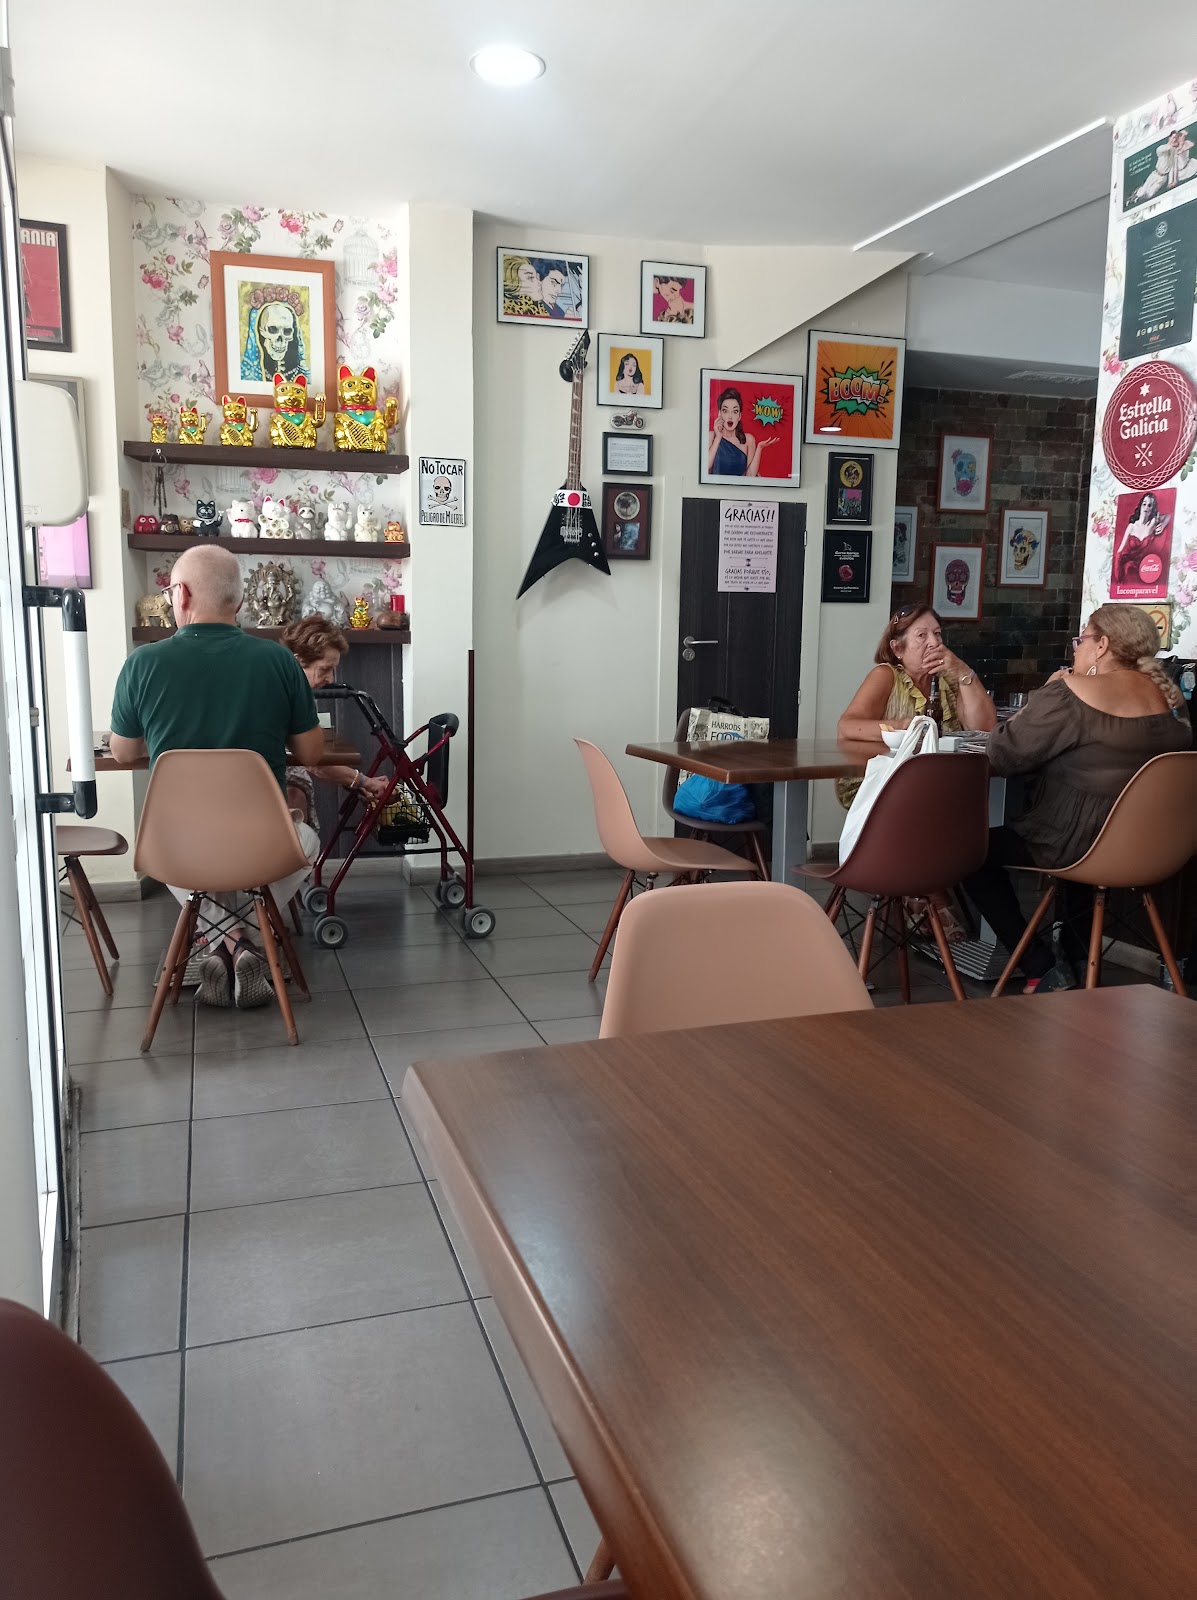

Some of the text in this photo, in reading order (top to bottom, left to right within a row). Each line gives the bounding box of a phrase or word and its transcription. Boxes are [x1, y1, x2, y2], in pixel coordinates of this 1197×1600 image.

[828, 377, 889, 403] BOOM!
[755, 404, 783, 419] WOW!
[1119, 395, 1172, 421] Estrella
[1120, 415, 1169, 439] Galicia
[435, 461, 464, 476] TOCAR
[725, 508, 775, 522] GRACIAS!!
[711, 721, 741, 731] HARRODS
